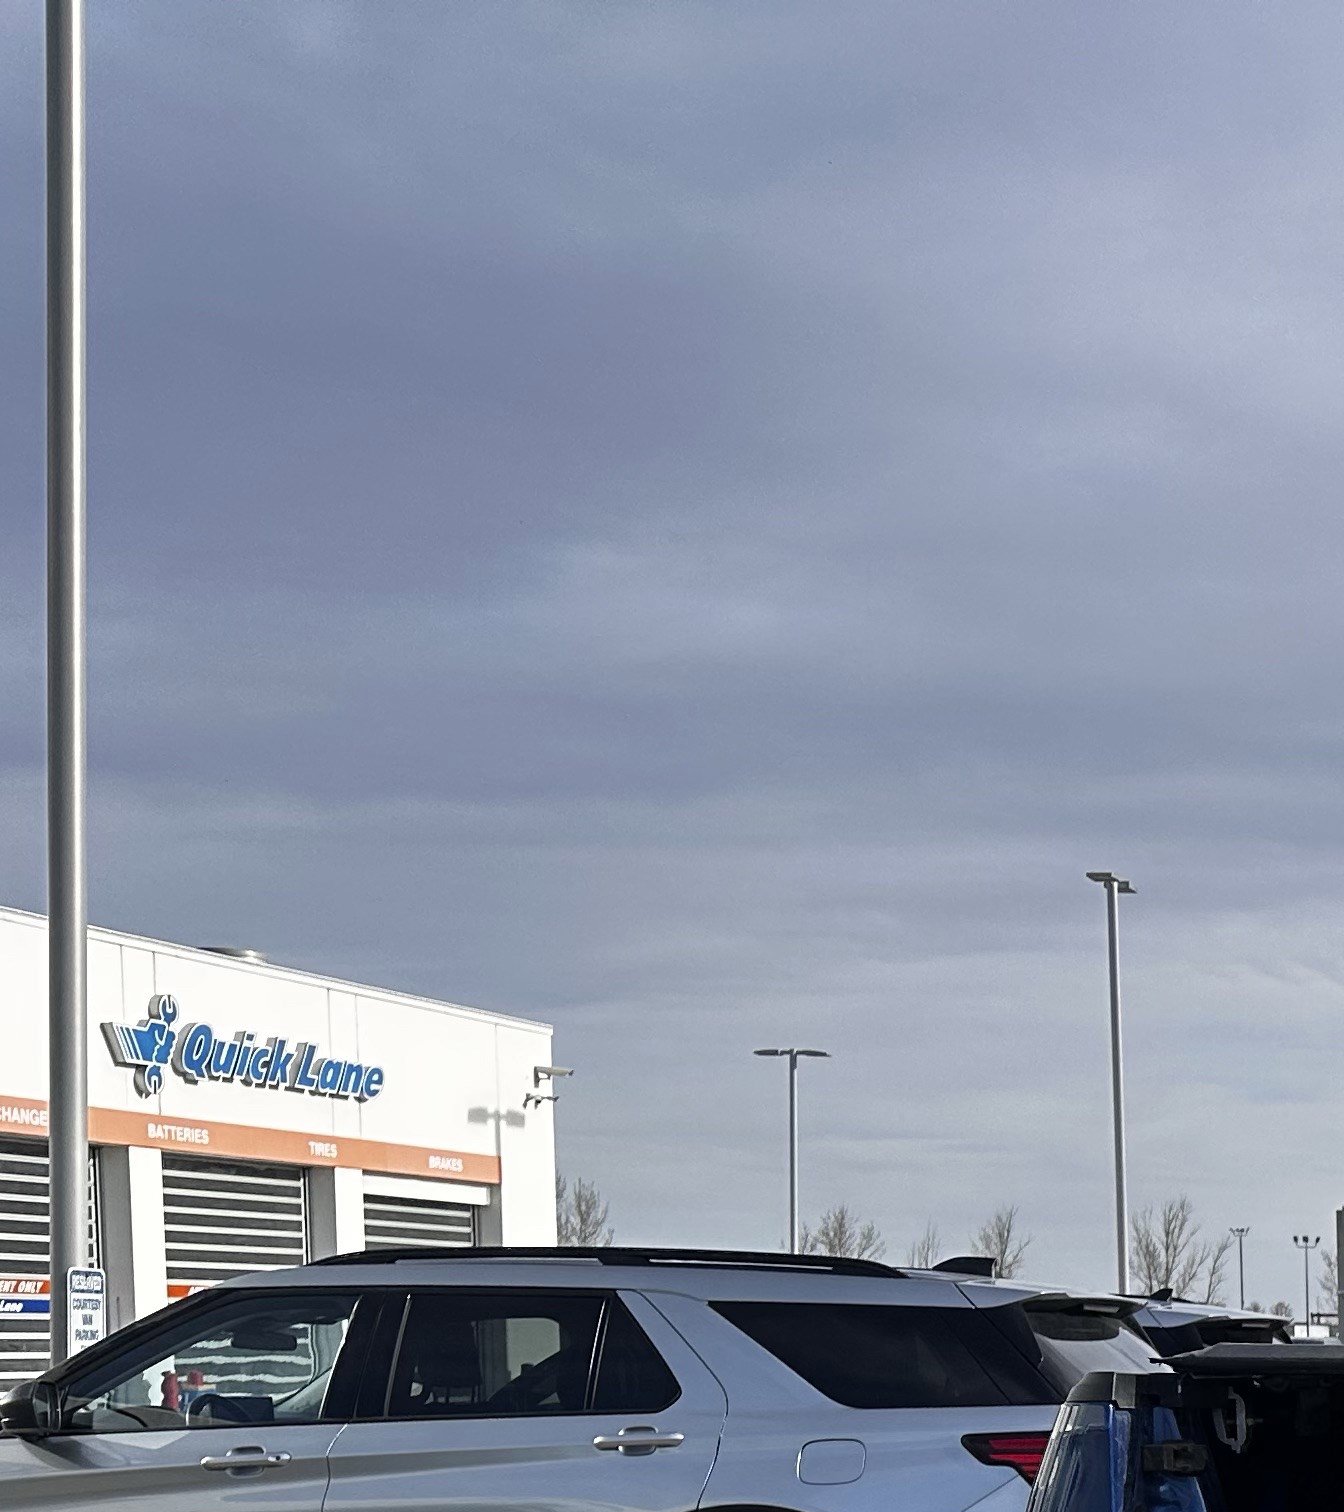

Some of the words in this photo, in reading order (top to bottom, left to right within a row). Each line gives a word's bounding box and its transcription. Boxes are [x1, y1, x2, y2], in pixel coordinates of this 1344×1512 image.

[182, 1023, 294, 1084] Quick
[297, 1043, 384, 1101] Lane
[147, 1123, 209, 1144] BATTERIES
[308, 1141, 337, 1158] TIRES
[428, 1155, 463, 1172] BRAKES
[17, 1280, 44, 1293] ONLY
